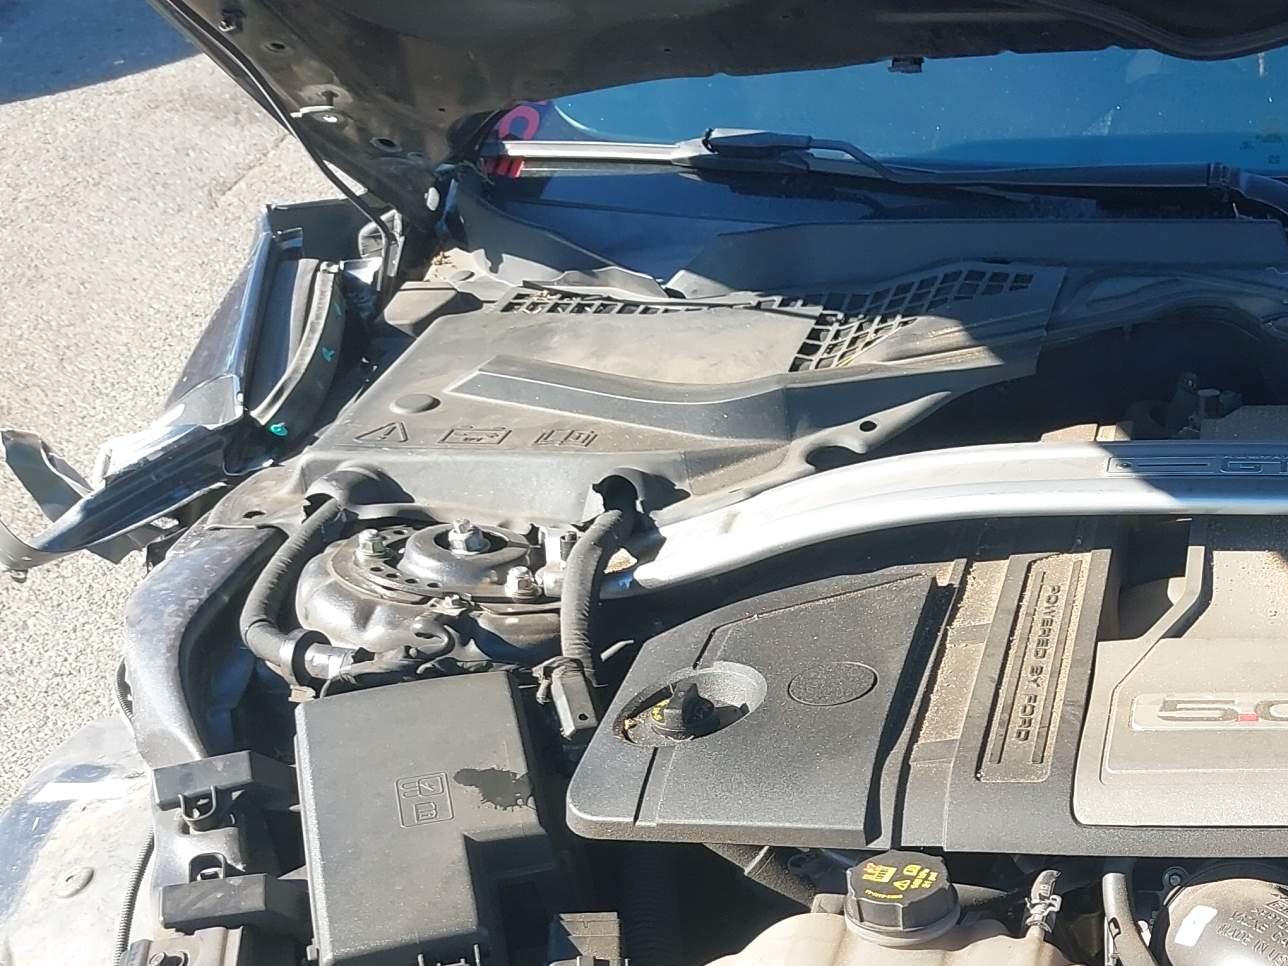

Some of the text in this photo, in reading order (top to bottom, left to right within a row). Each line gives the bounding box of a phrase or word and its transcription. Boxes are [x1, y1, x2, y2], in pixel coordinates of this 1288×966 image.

[1015, 584, 1062, 742] POWERED BY FORD
[1216, 922, 1254, 946] MADE
[1253, 939, 1269, 955] IN
